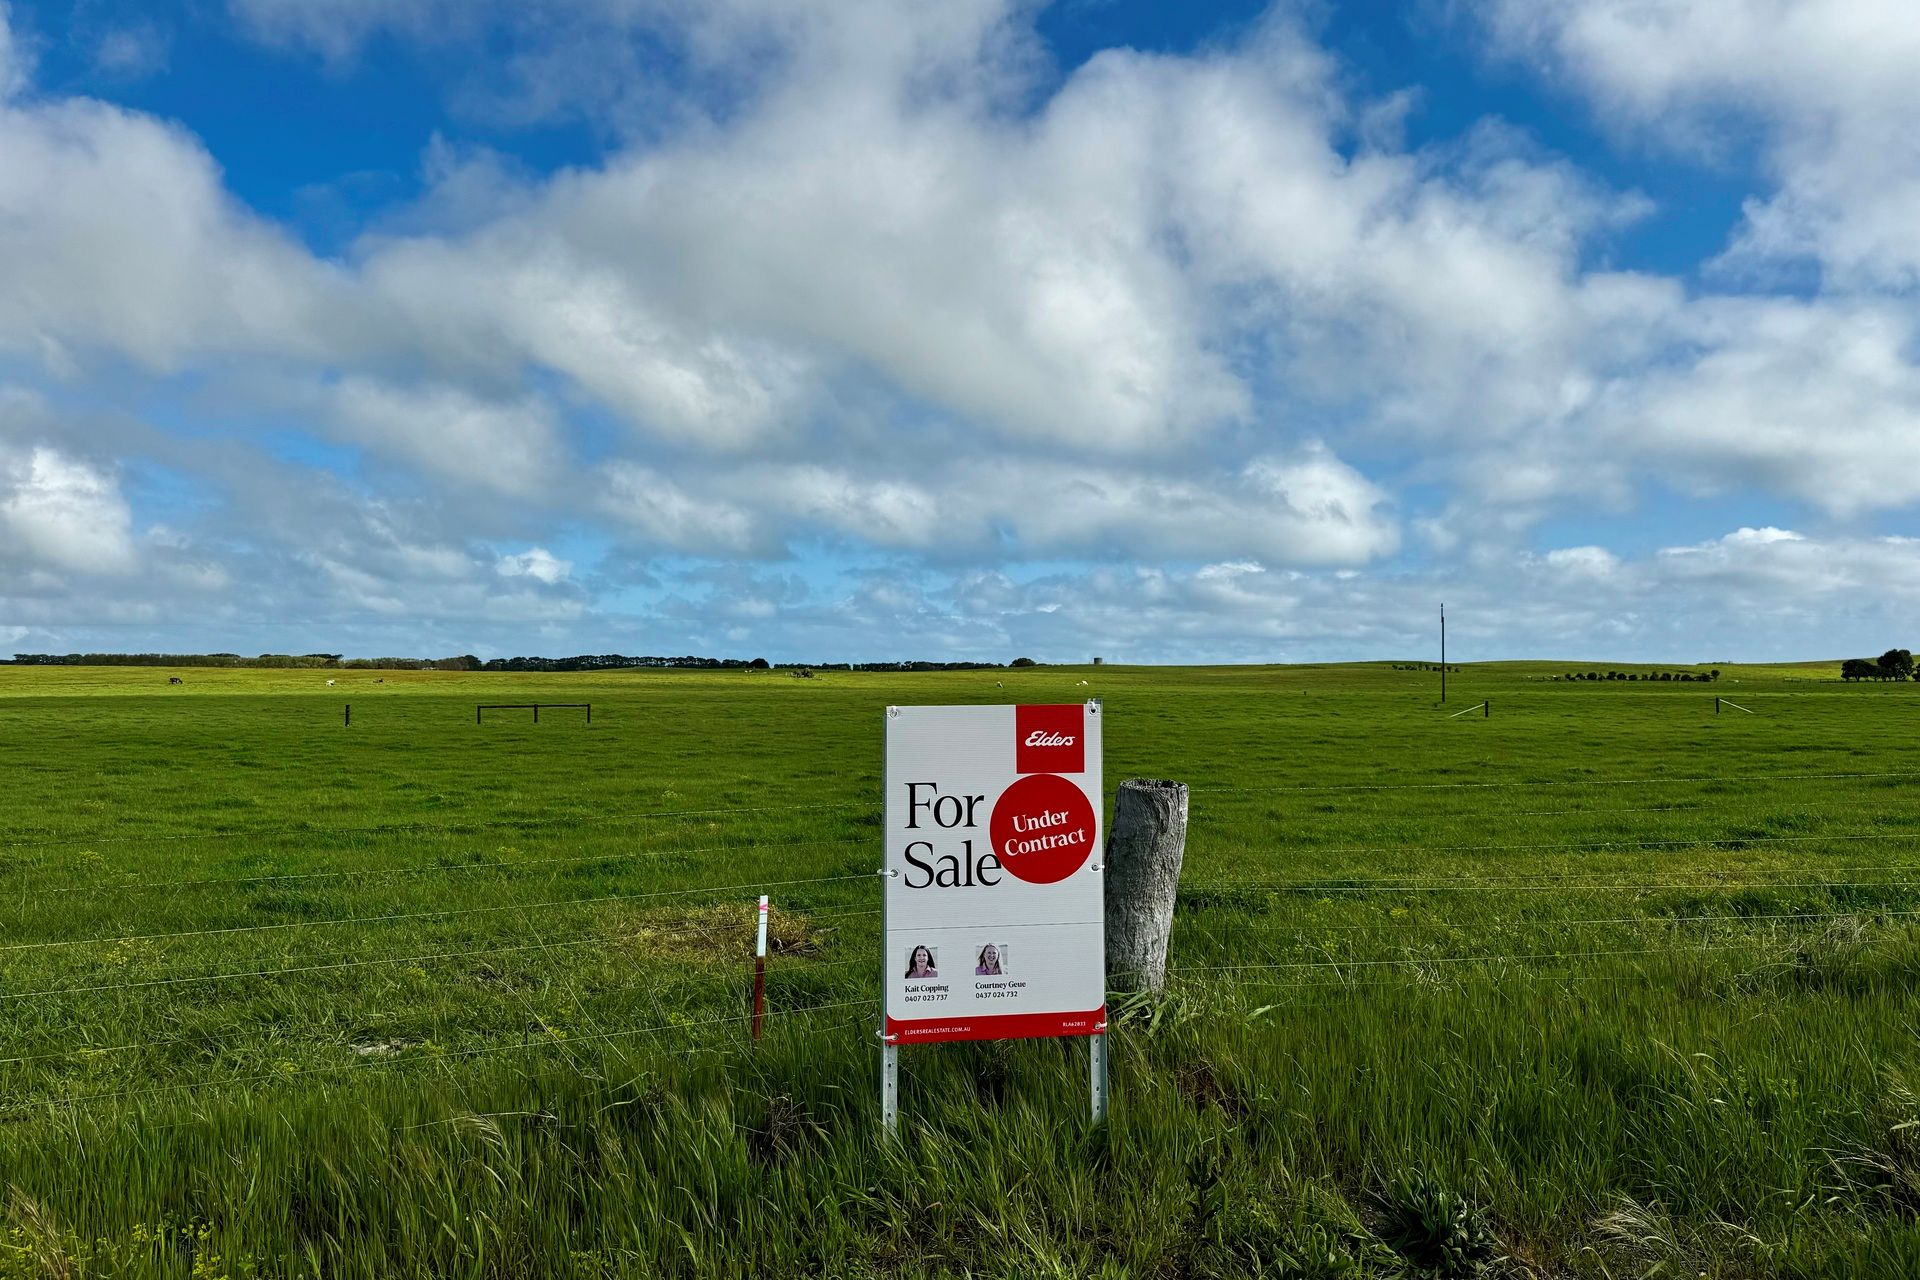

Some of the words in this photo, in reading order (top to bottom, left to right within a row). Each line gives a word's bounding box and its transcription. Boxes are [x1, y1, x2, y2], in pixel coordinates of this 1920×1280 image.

[1025, 730, 1075, 747] Elders
[904, 782, 984, 829] For
[1012, 810, 1069, 833] Under
[1004, 827, 1087, 857] Contract
[904, 839, 1002, 889] Sale
[905, 985, 919, 993] Kait
[920, 984, 949, 993] Copping
[975, 981, 1007, 990] Courtney
[904, 1026, 971, 1035] ELDERSREALESTATE.COM.AU
